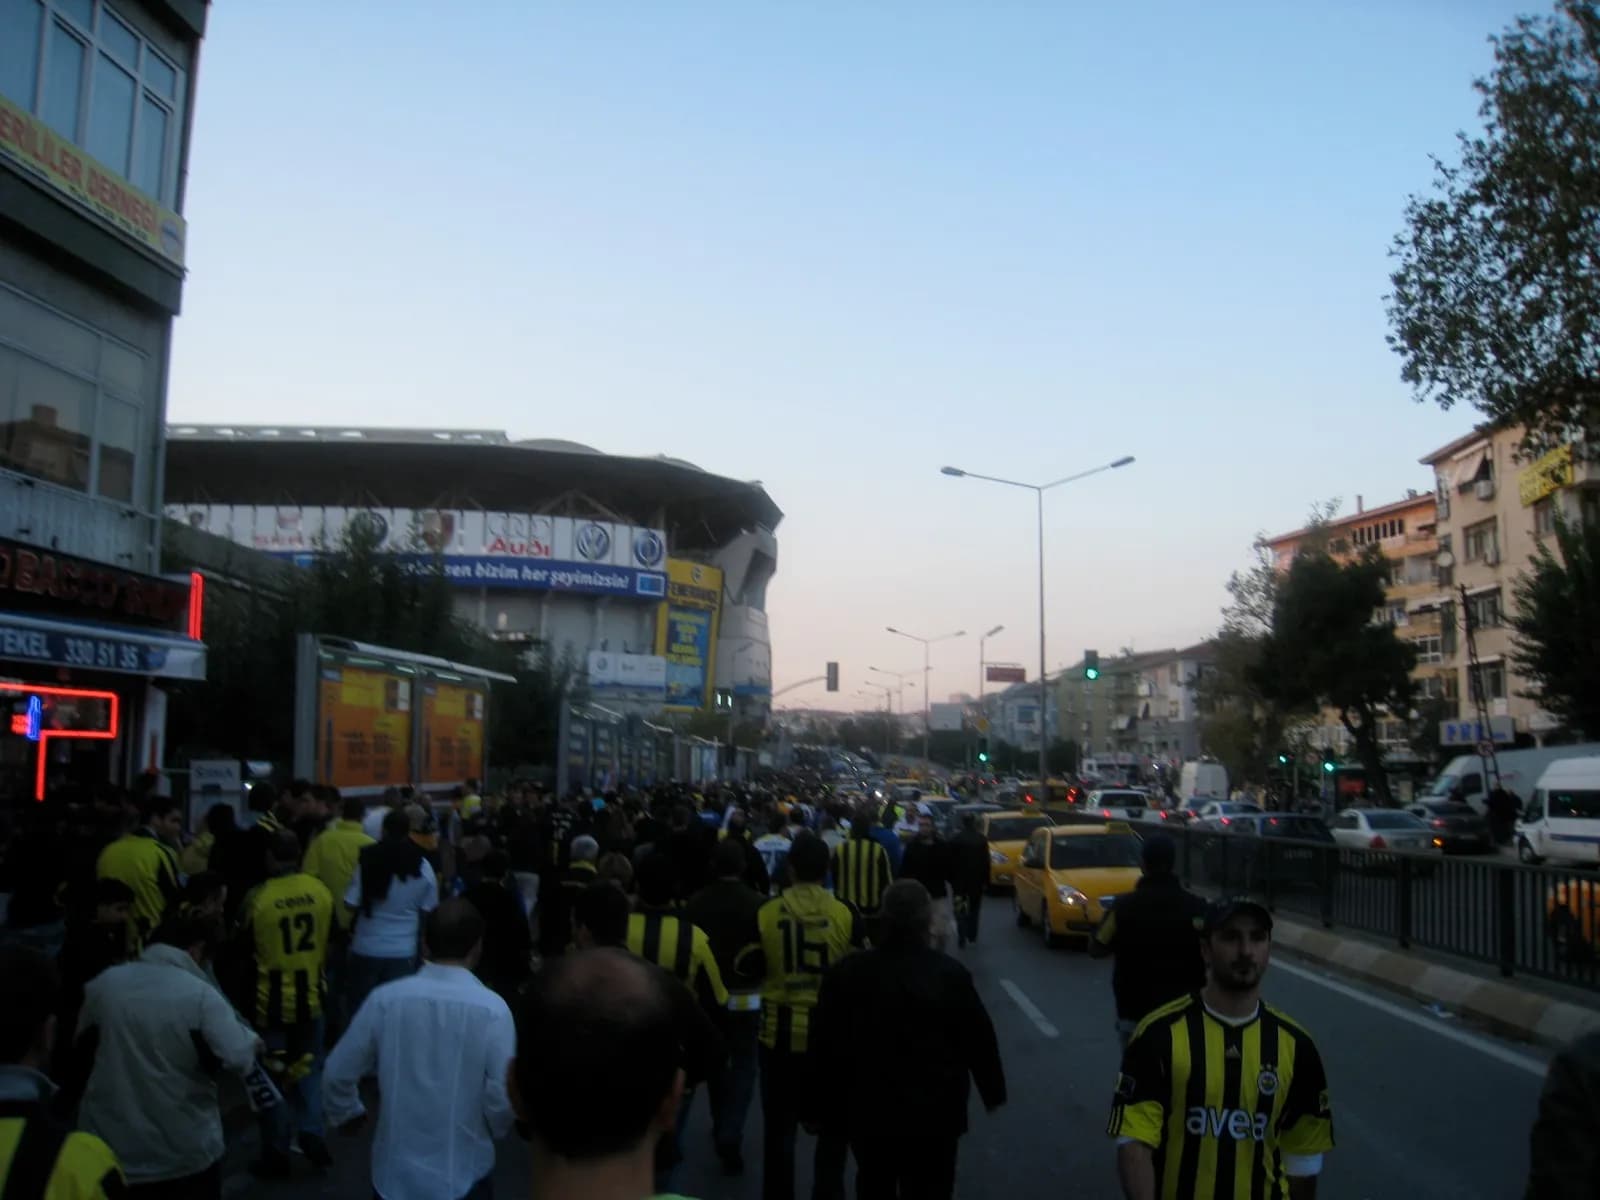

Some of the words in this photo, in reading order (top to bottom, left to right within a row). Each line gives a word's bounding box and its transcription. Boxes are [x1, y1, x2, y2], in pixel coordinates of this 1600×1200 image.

[444, 563, 472, 578] sen
[475, 562, 519, 581] bizim
[521, 566, 547, 582] her
[98, 641, 115, 667] 51
[279, 913, 316, 955] 12
[1185, 1105, 1269, 1142] avea
